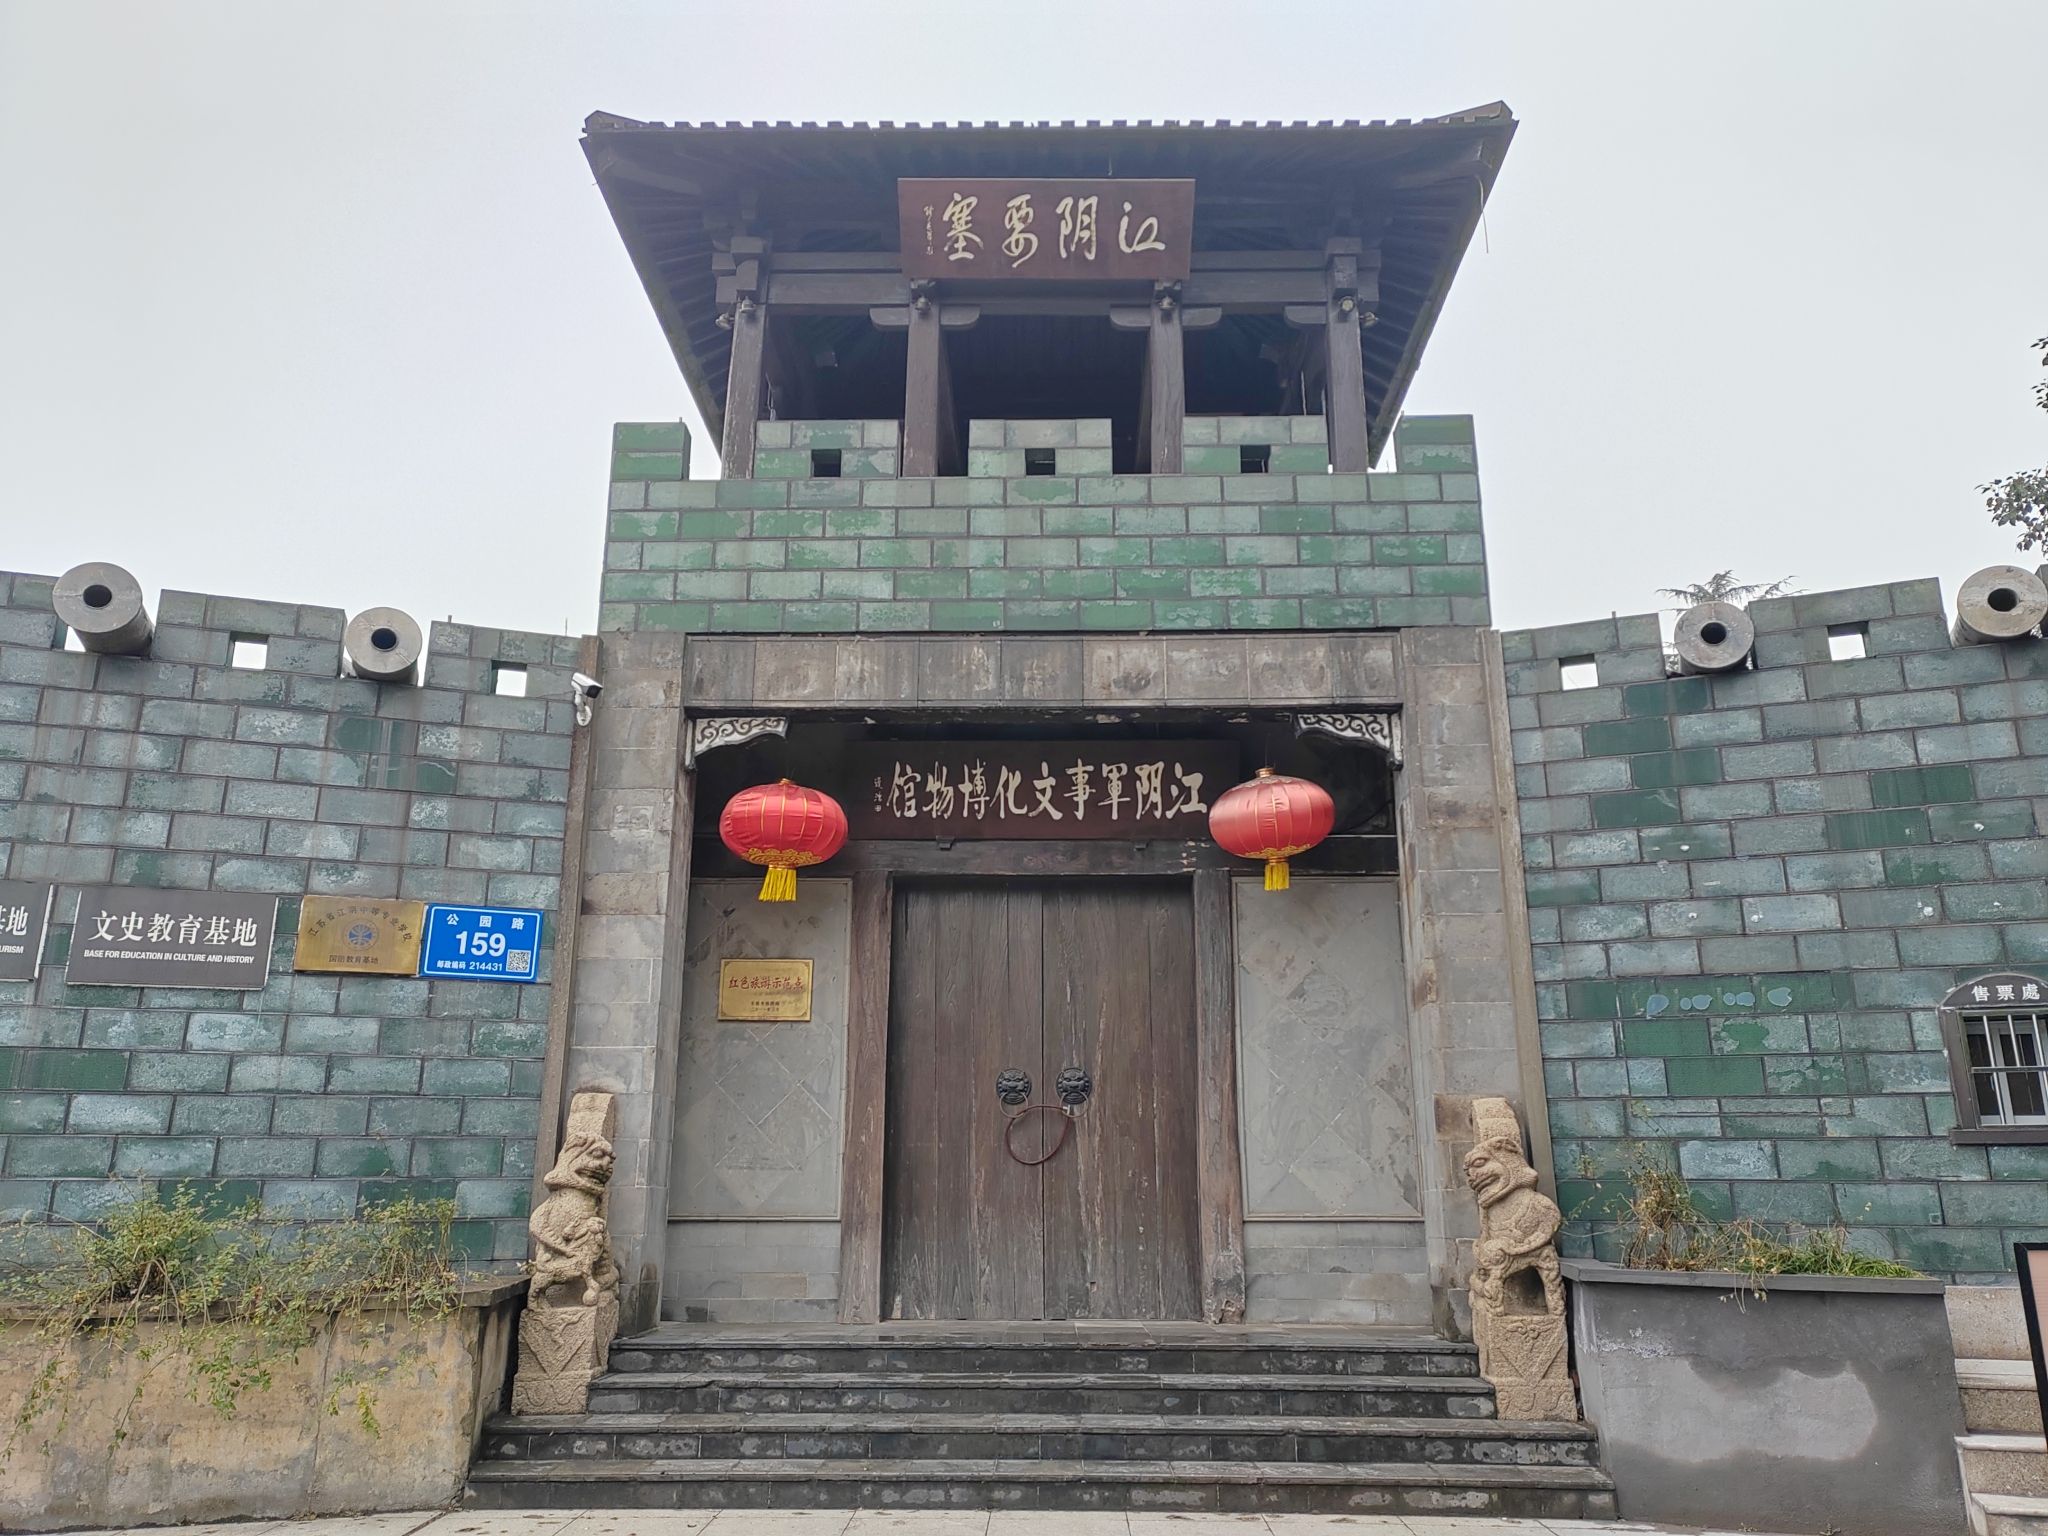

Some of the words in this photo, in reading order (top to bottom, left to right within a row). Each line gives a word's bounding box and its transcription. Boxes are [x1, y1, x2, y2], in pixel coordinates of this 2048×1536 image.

[87, 909, 258, 947] 文史教育基地
[446, 913, 525, 931] 公园路
[455, 930, 507, 957] 159
[83, 949, 104, 958] BASE
[104, 950, 120, 959] FOR
[120, 951, 163, 960] EDUCATION
[163, 952, 173, 960] IN
[173, 953, 207, 962] CULTURE
[206, 955, 223, 963] AND
[223, 955, 255, 964] HISTORY
[436, 959, 467, 970] 邮政编码
[468, 961, 503, 972] 214431
[1971, 983, 2040, 1002] 售票處
